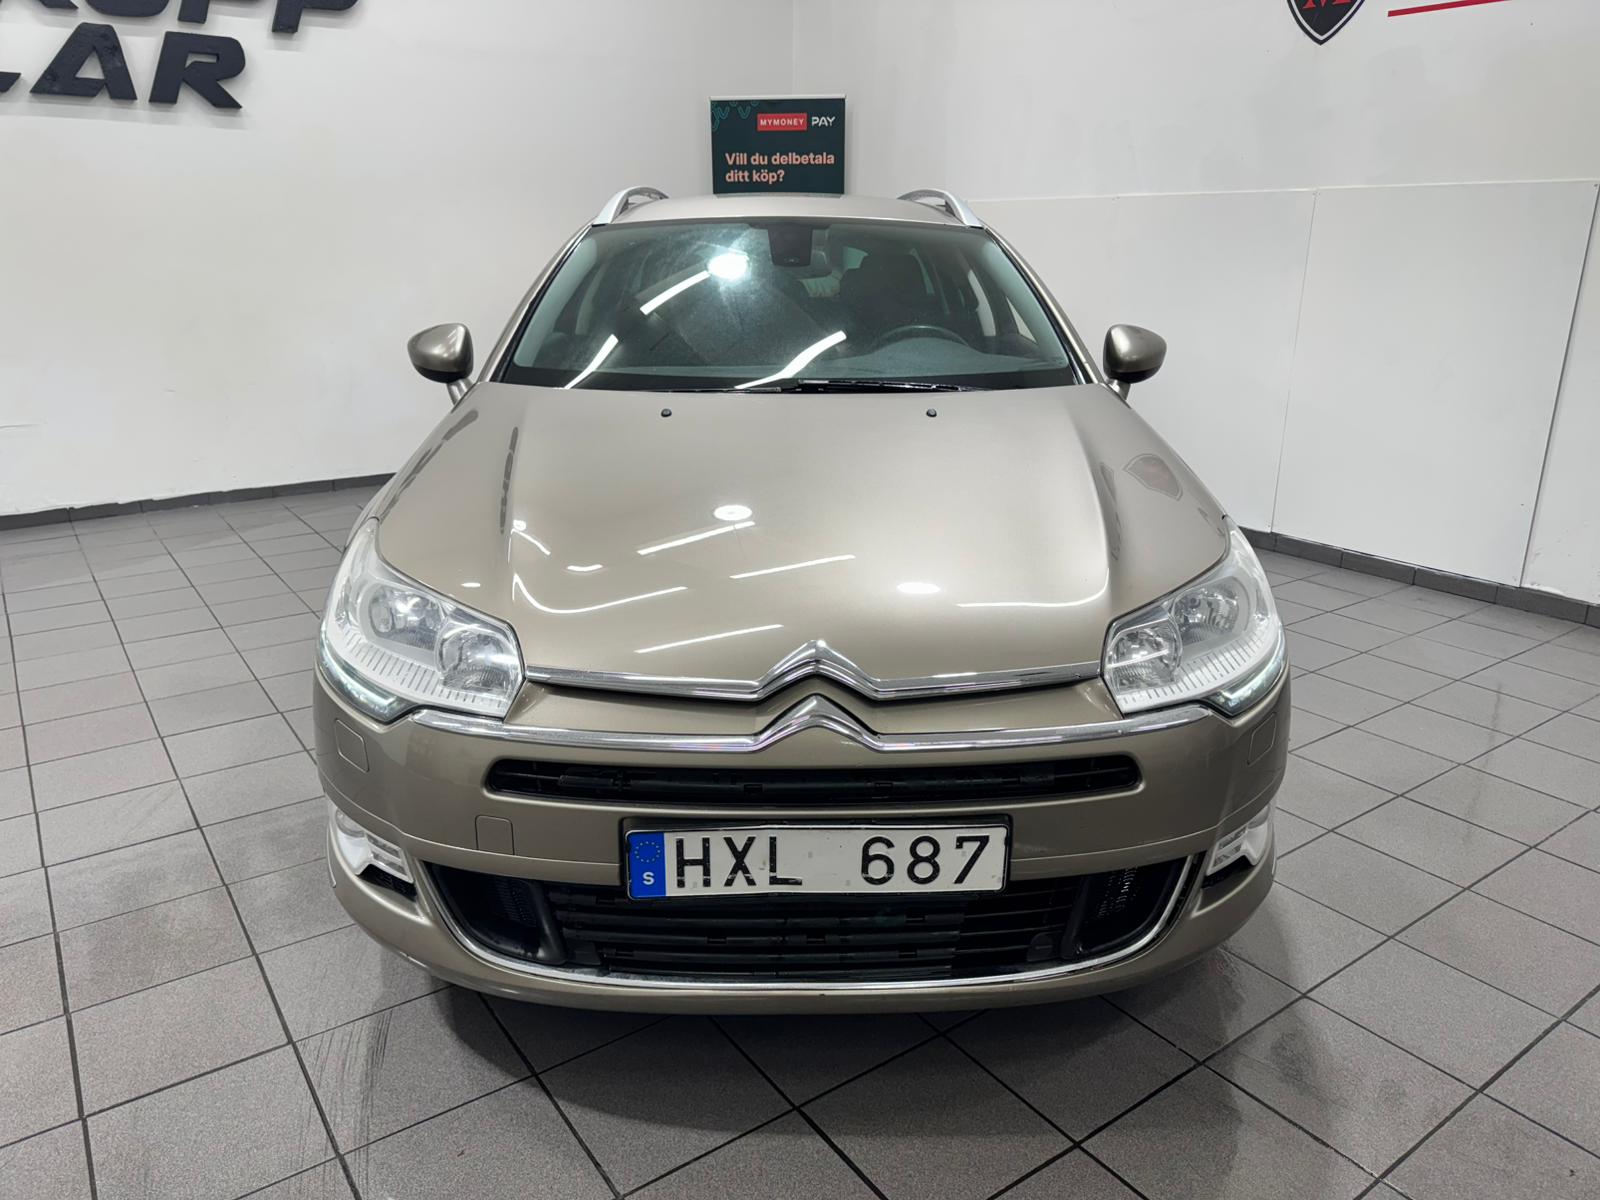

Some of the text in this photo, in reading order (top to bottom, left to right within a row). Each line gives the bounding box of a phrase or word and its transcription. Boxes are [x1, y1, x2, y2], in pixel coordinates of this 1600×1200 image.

[760, 116, 835, 126] MYMONEY PAY
[725, 152, 835, 165] Vill du delbetala
[725, 169, 785, 184] ditt köp?
[676, 835, 990, 888] HXL 687
[642, 871, 655, 885] S
